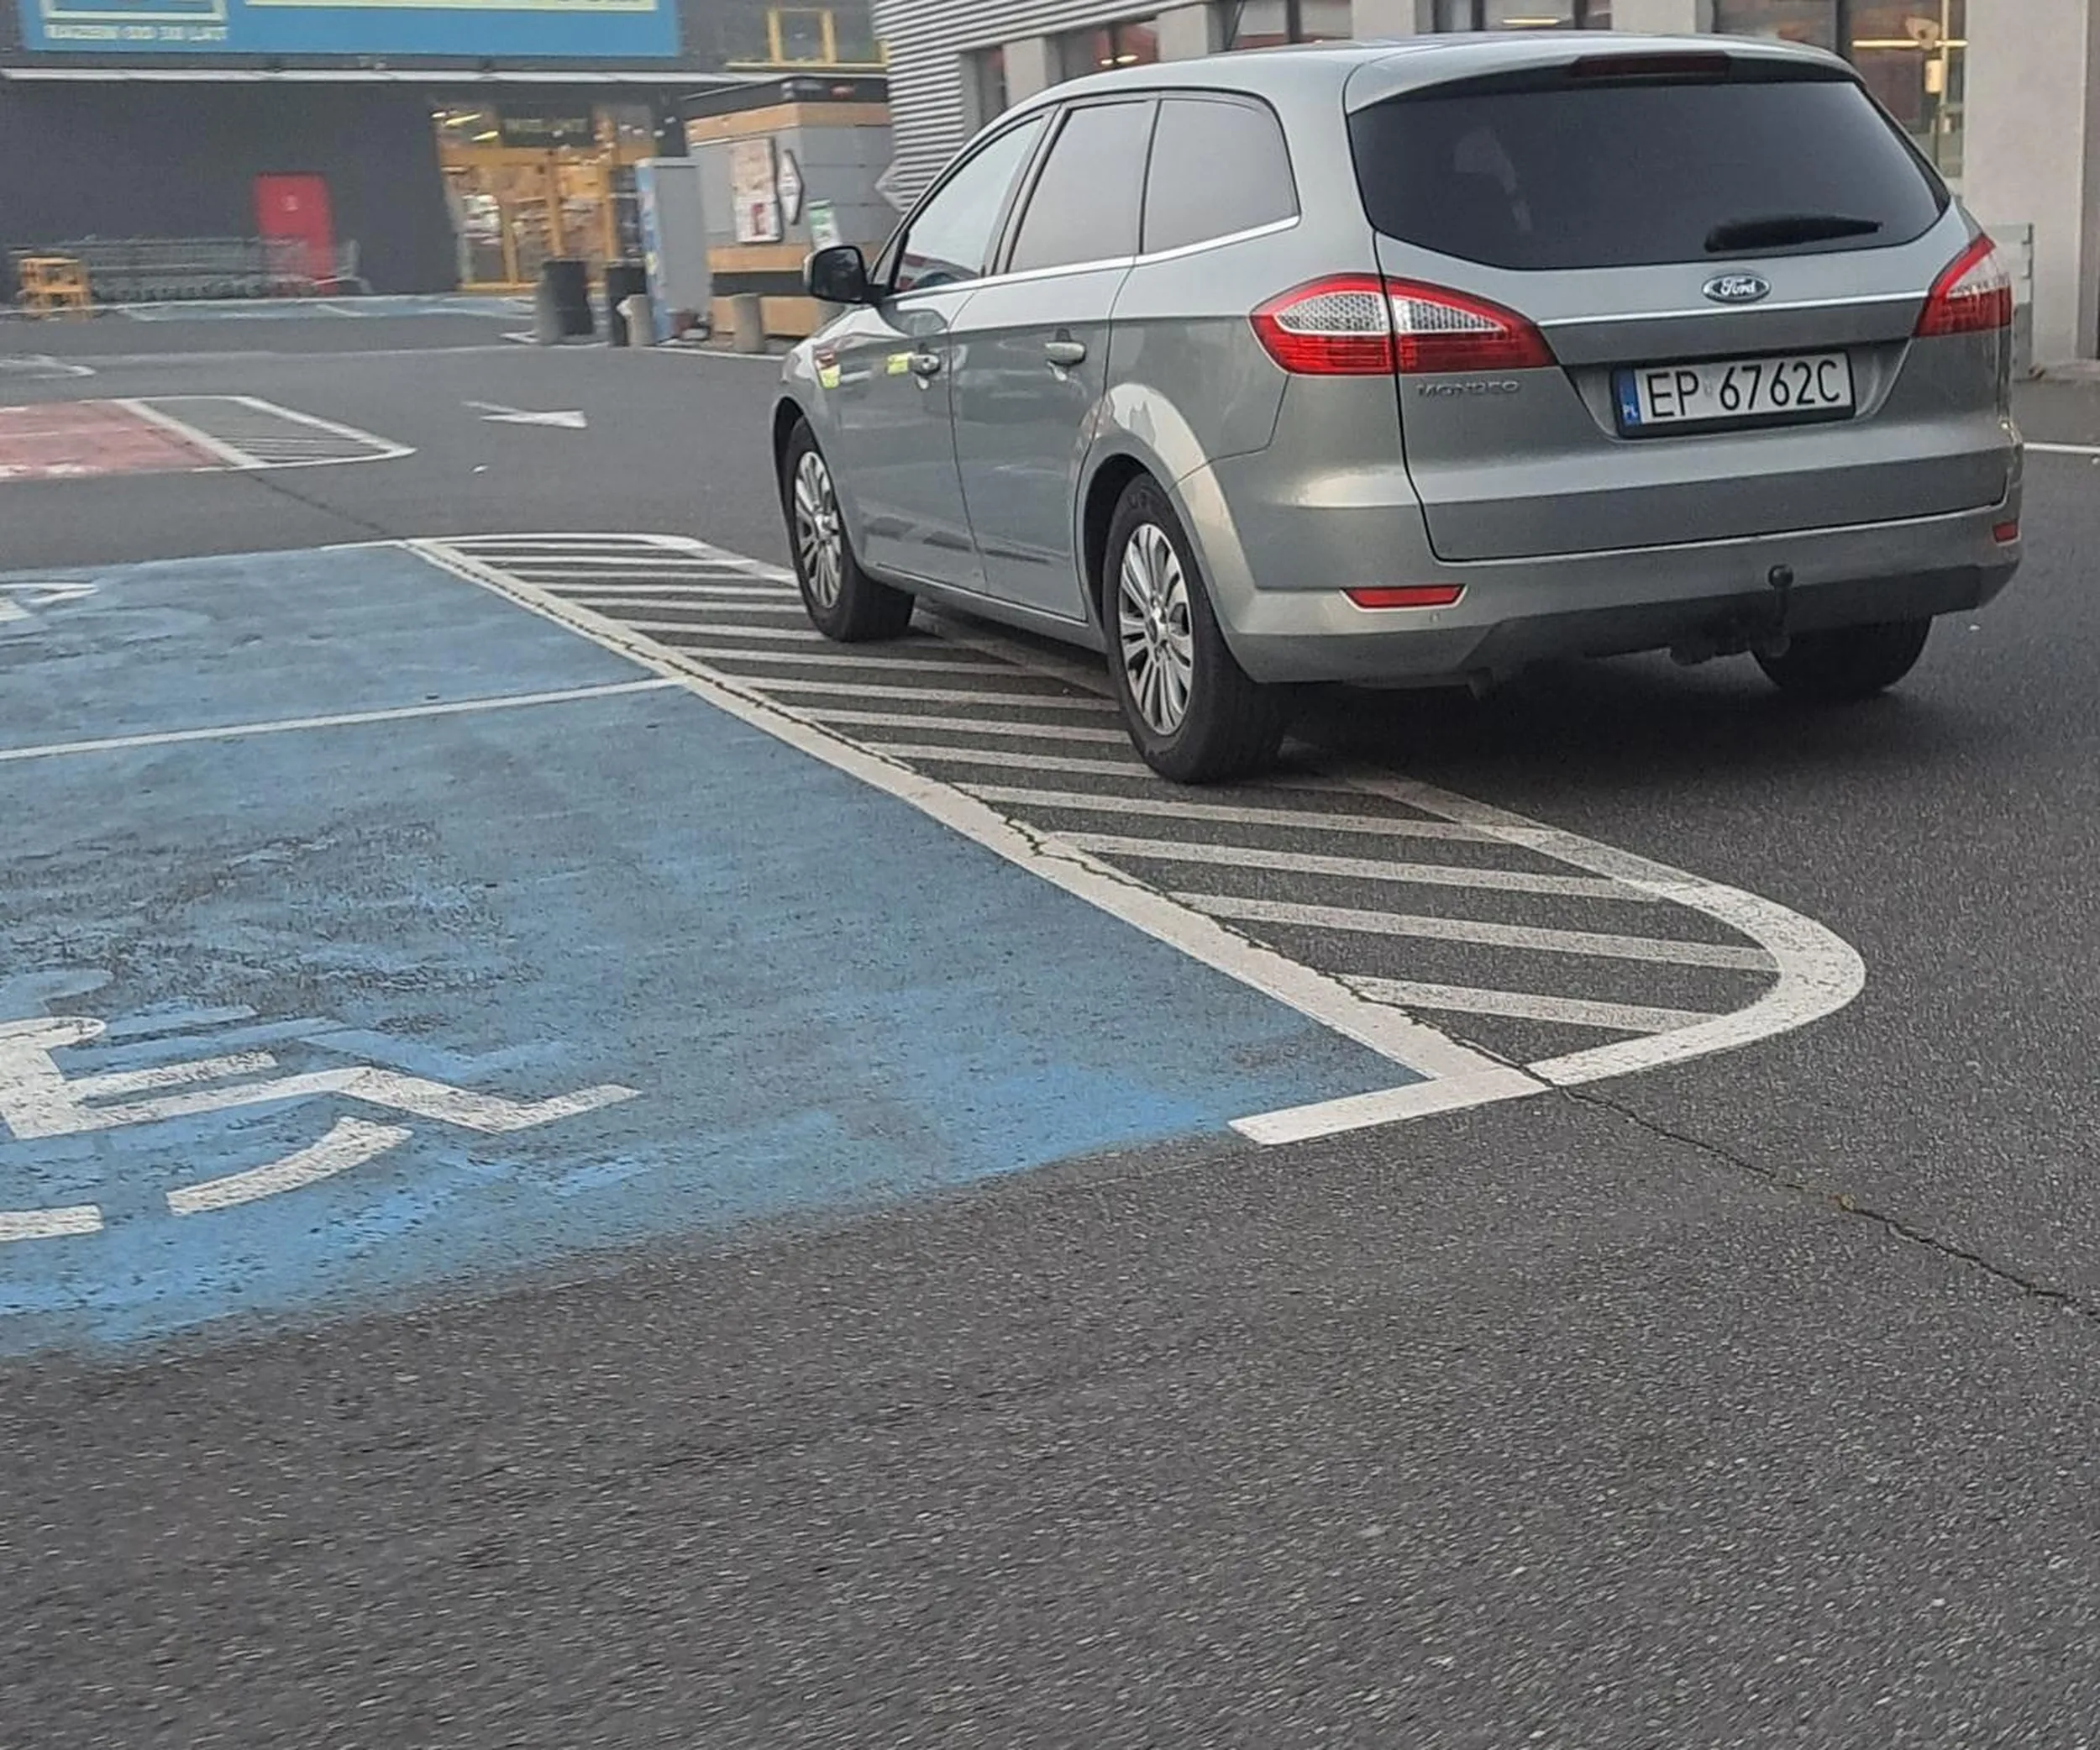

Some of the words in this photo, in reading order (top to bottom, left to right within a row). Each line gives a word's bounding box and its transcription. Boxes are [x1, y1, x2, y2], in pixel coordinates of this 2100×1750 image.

[1719, 276, 1756, 296] Ford
[1646, 370, 1699, 418] EP
[1719, 359, 1840, 411] 6762C
